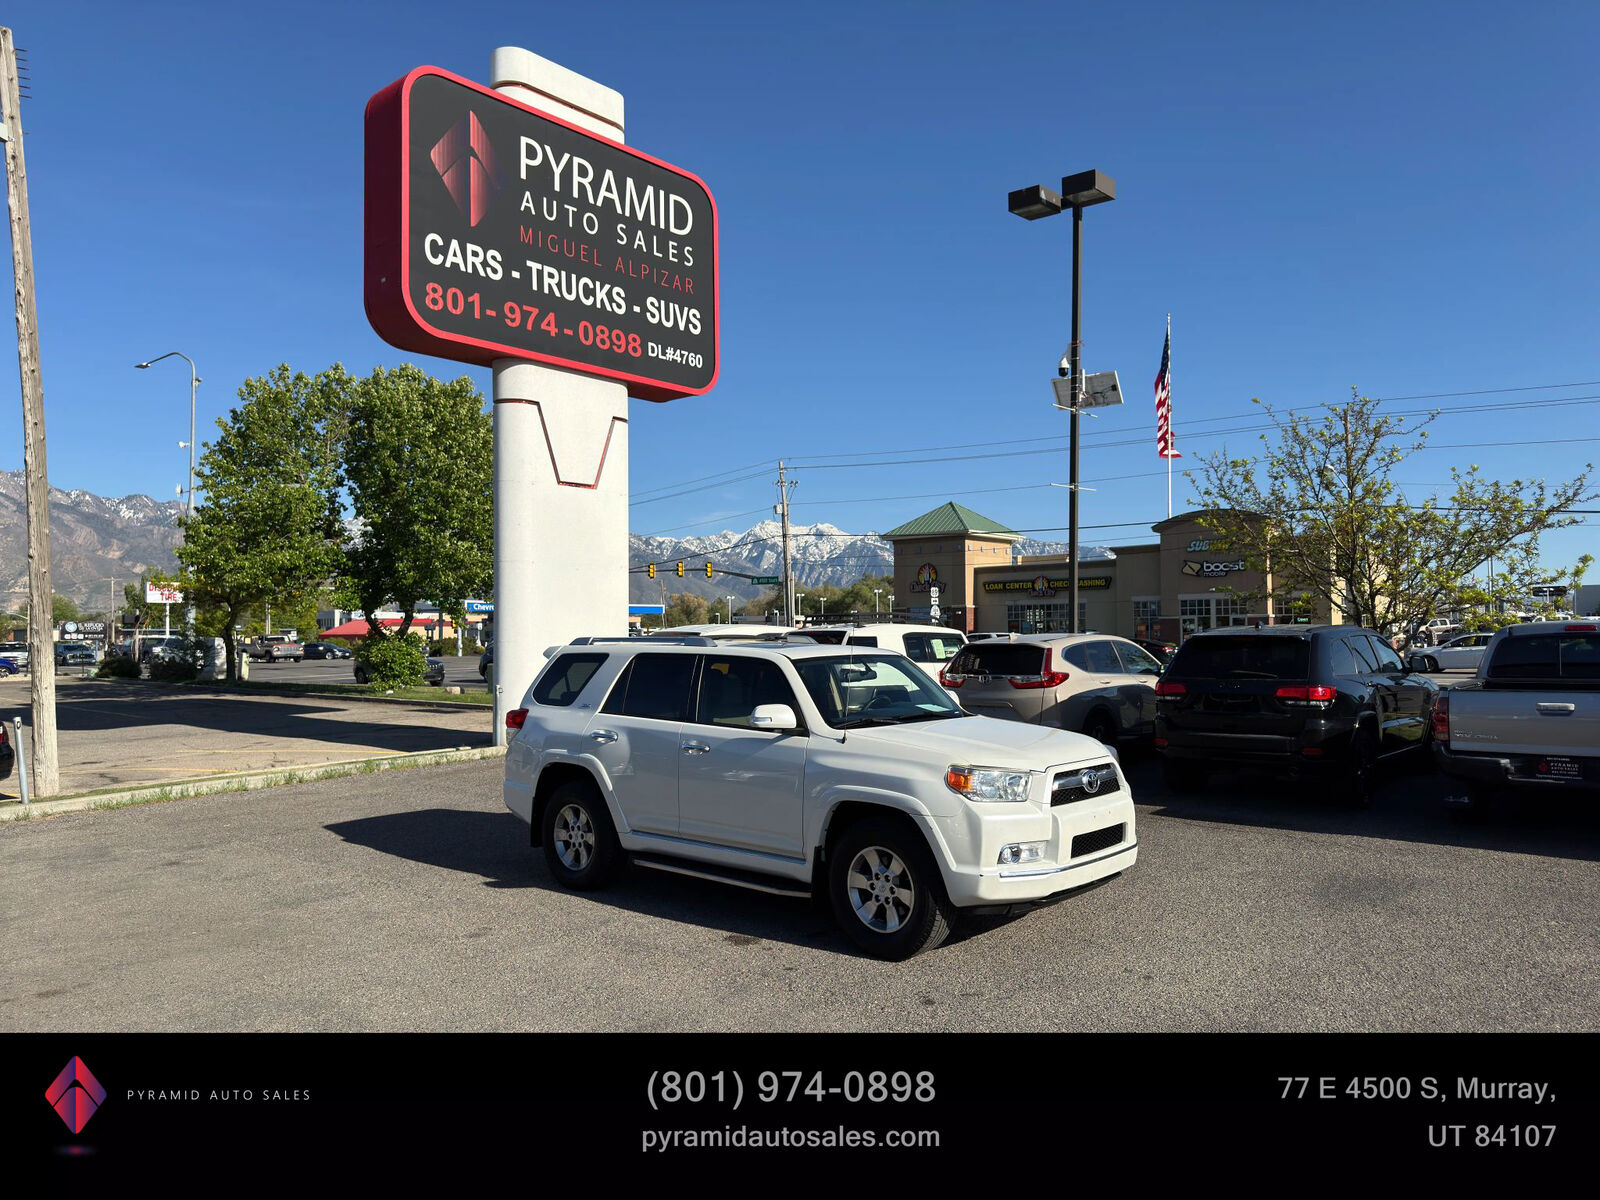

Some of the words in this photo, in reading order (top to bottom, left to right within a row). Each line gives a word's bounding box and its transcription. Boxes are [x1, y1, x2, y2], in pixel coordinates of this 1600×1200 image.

[520, 136, 693, 236] PYRAMID
[520, 191, 599, 235] AUTO
[616, 223, 694, 267] SALES
[424, 233, 504, 281] CARS
[526, 260, 627, 315] TRUCKS
[646, 296, 702, 335] SUVS
[520, 225, 602, 267] MIGUEL
[615, 256, 694, 295] ALPIZAR
[647, 341, 703, 369] DL#4760
[1078, 579, 1106, 587] ASHING
[1203, 560, 1245, 572] boost
[160, 593, 177, 601] TIRE
